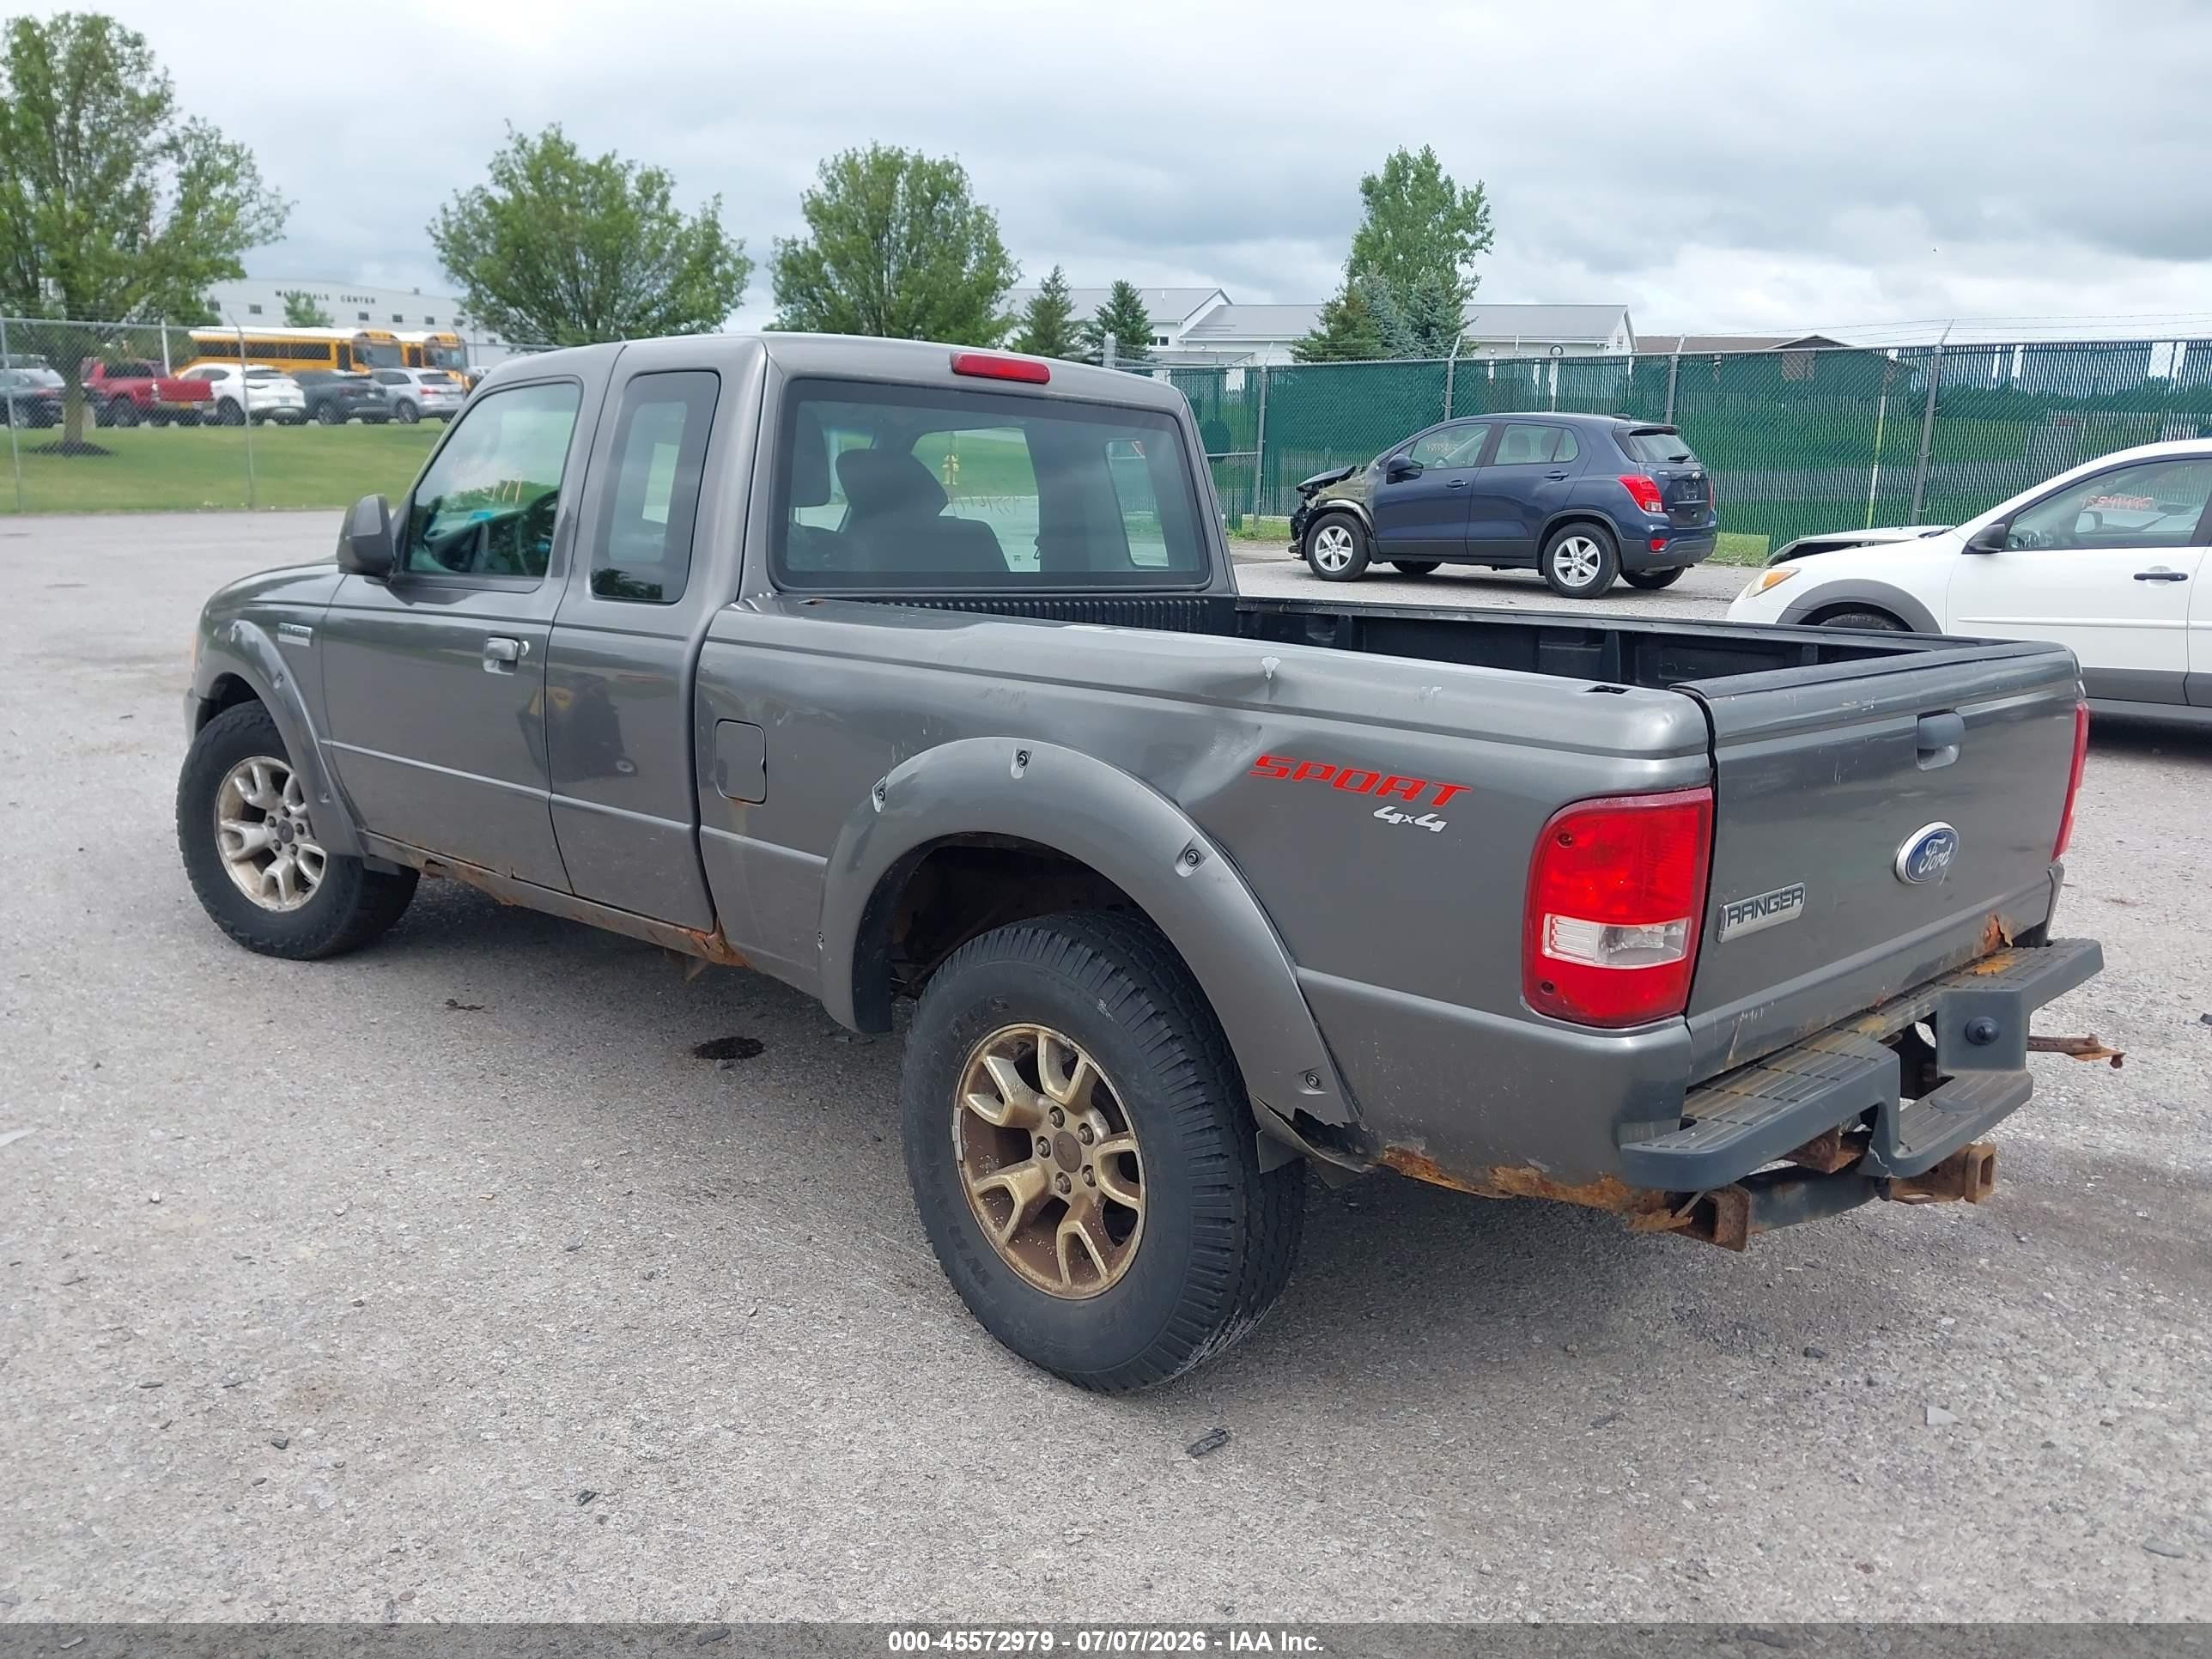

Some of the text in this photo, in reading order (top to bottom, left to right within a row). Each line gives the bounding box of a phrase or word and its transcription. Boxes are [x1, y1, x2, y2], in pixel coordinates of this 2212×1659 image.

[1250, 755, 1473, 808] SPORT
[1373, 805, 1448, 833] 4x4
[1918, 838, 1954, 874] Ford
[1727, 886, 1804, 928] RANGER
